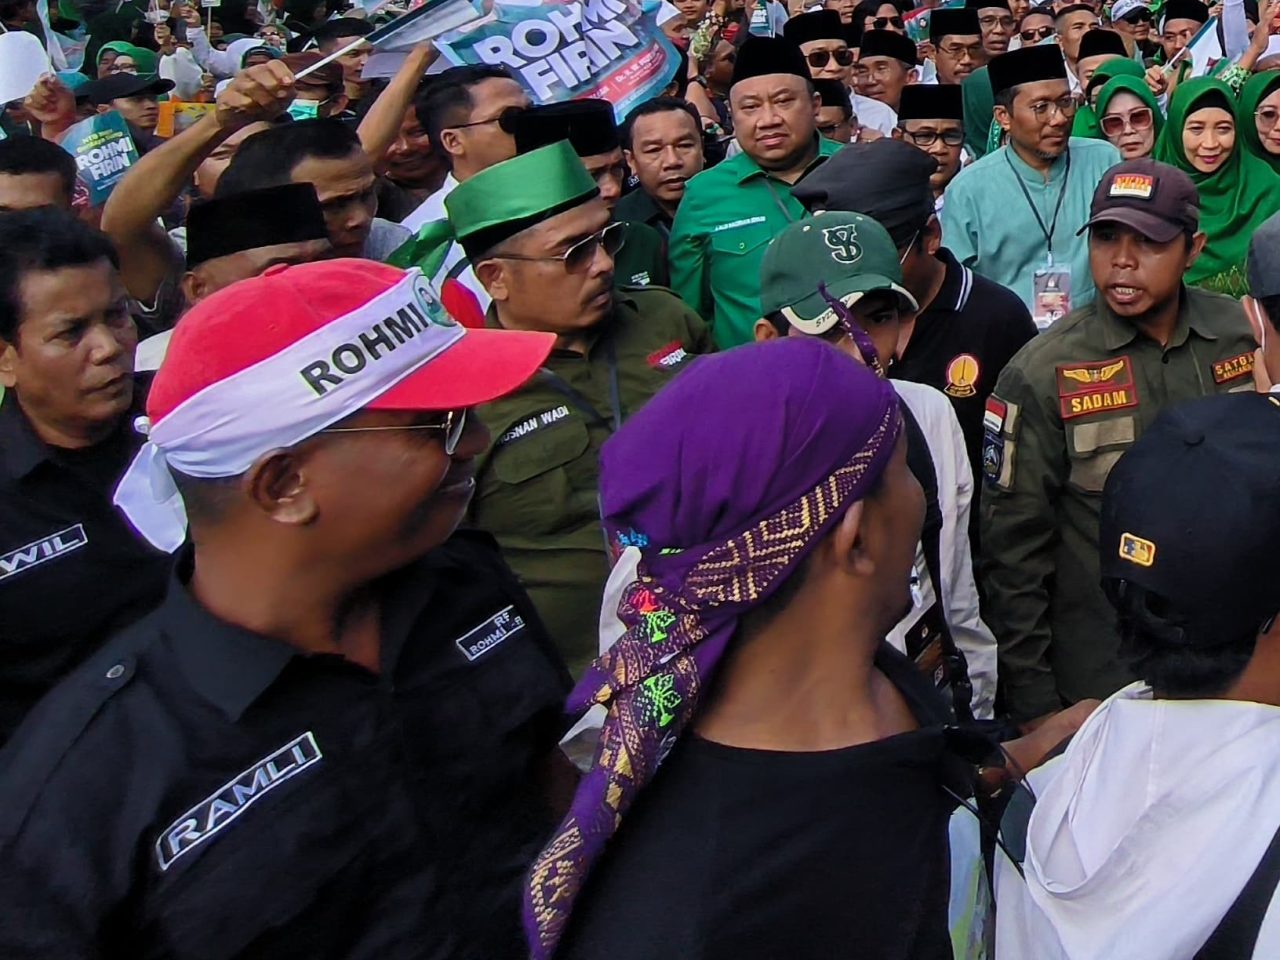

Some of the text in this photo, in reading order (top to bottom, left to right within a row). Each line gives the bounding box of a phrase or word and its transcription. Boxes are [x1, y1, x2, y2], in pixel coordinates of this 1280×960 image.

[519, 20, 640, 102] FIRIN
[75, 136, 133, 171] ROHMI
[89, 152, 132, 181] FIRIN
[300, 303, 429, 397] ROHMI
[541, 405, 569, 424] WADI
[1071, 390, 1127, 413] SADAM
[469, 626, 507, 655] ROHMI
[166, 744, 309, 856] RAMLI
